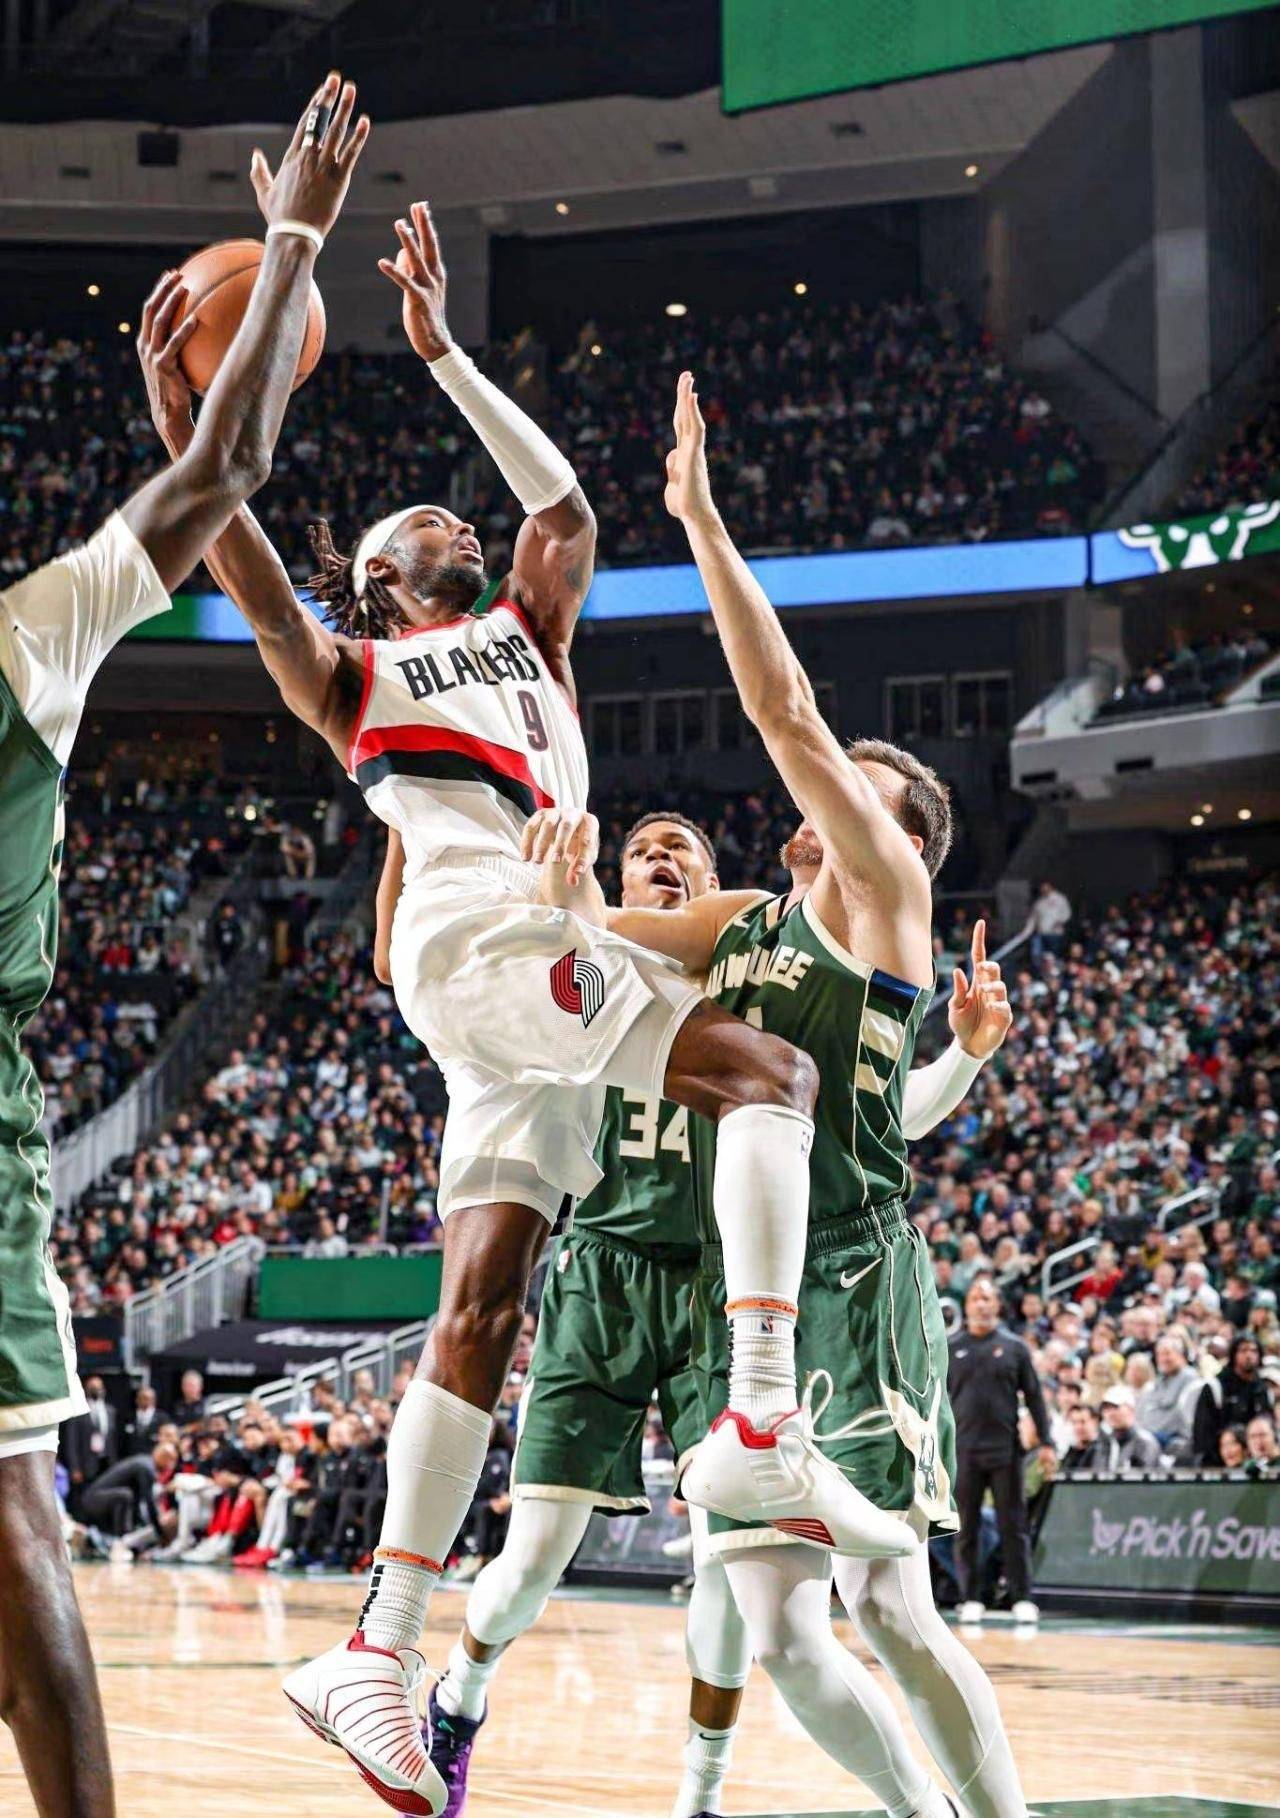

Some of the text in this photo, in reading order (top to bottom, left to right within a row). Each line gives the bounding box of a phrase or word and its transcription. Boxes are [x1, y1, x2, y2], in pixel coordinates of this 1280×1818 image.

[517, 690, 549, 751] 9
[619, 1087, 691, 1162] 34
[1120, 1516, 1187, 1557] Pick
